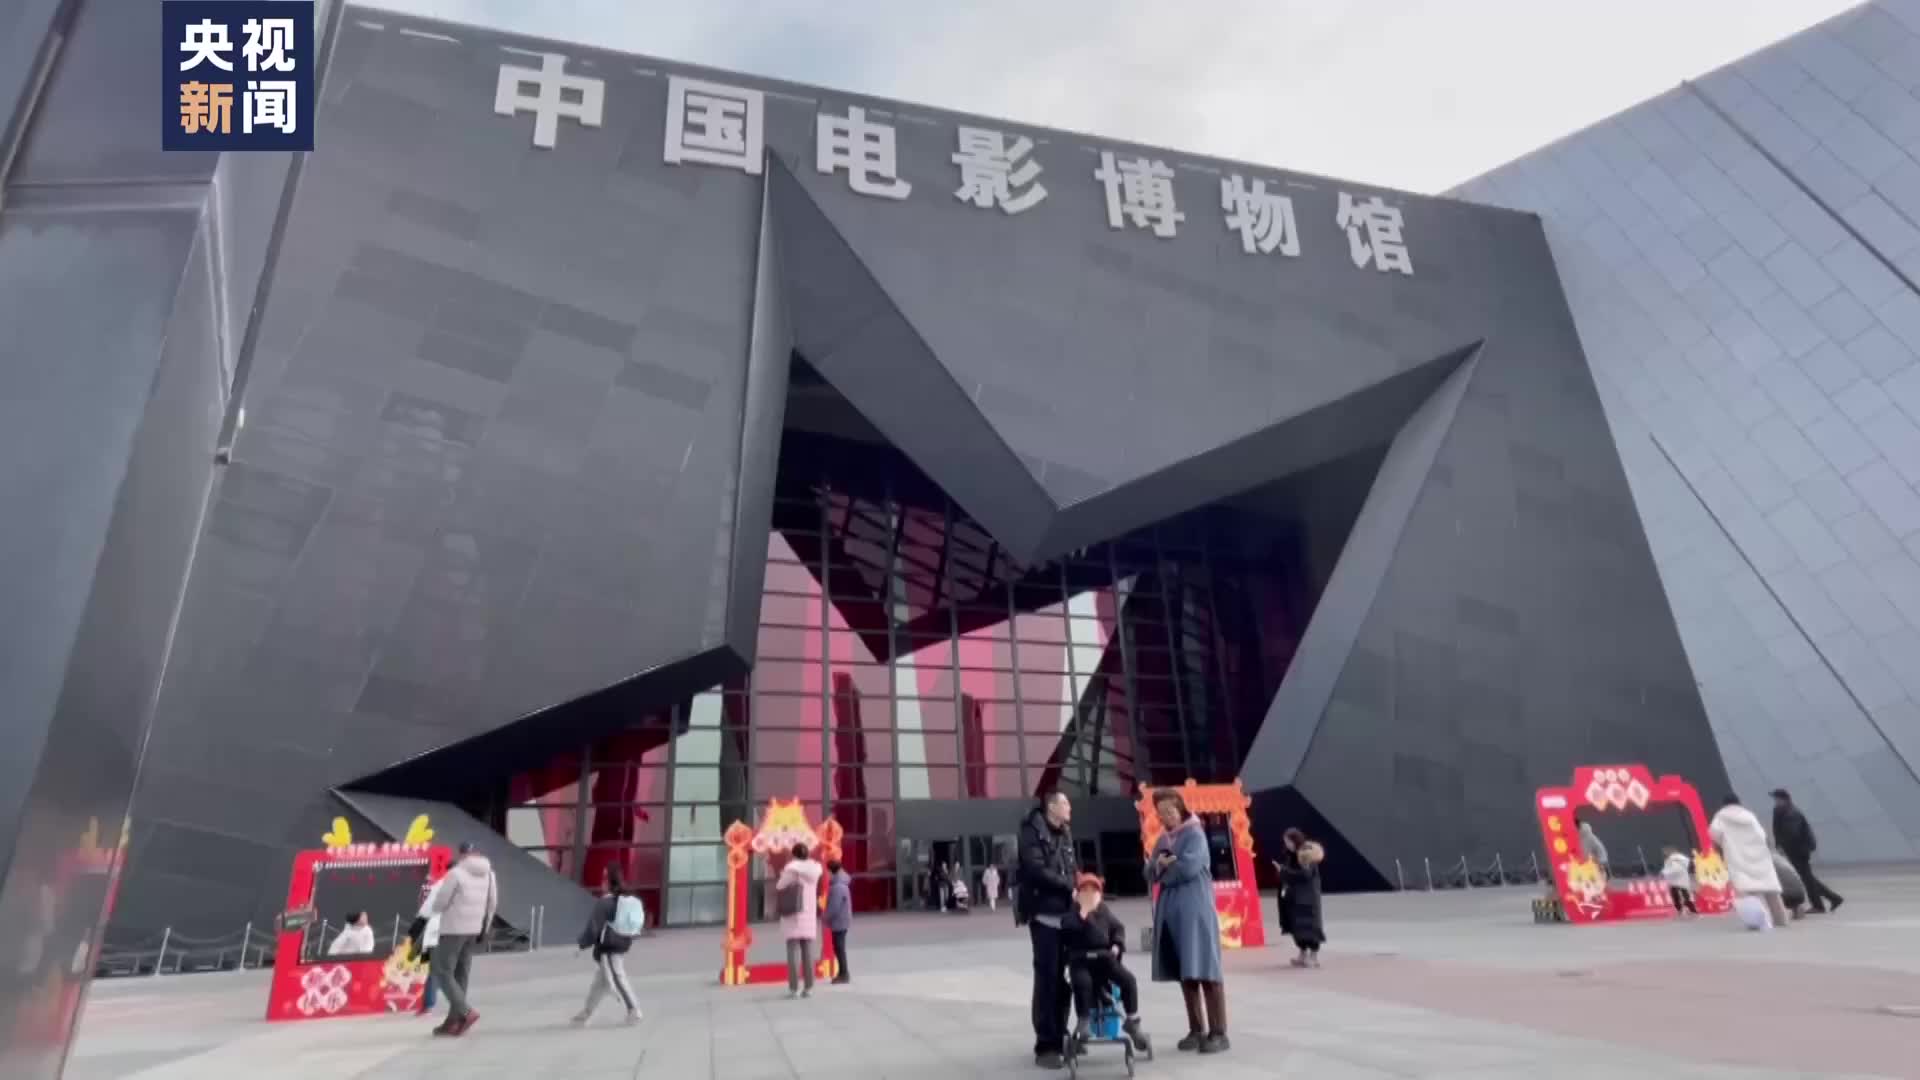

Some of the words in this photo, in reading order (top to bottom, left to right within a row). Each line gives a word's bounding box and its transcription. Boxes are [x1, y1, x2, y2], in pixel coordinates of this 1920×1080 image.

[494, 53, 1414, 275] 中国电影博物馆
